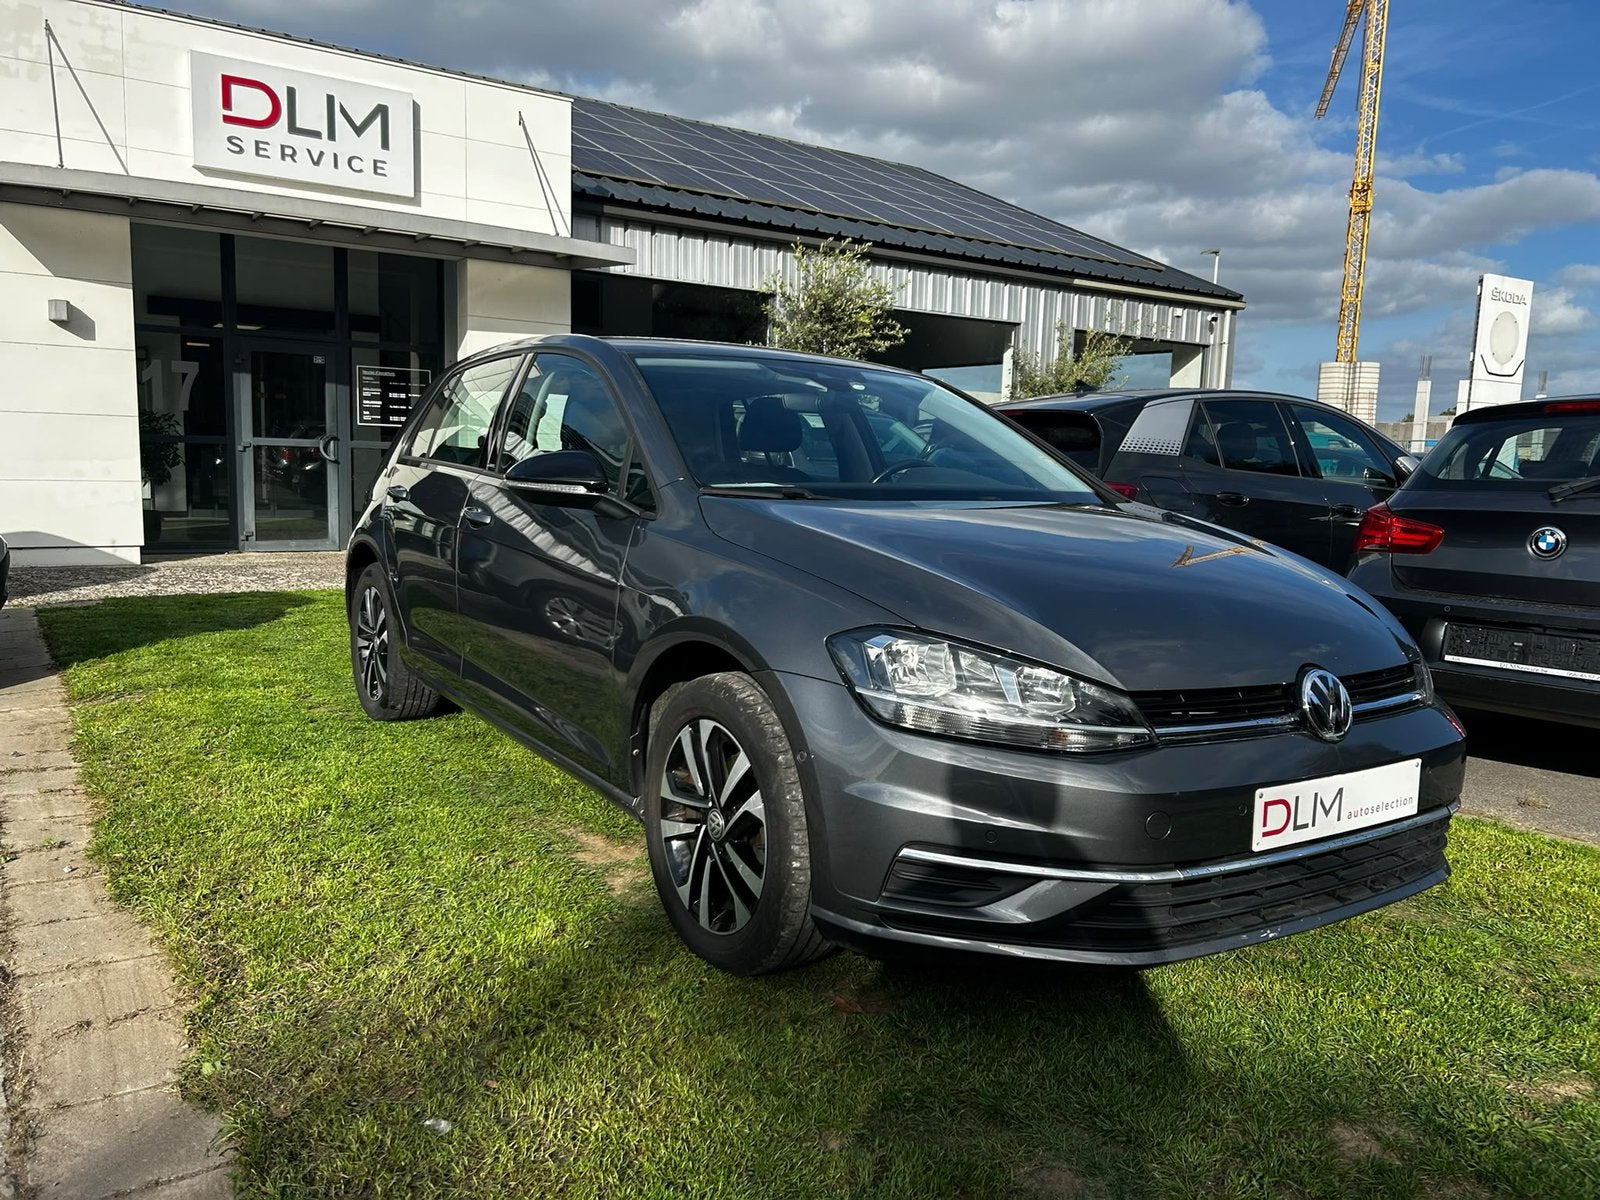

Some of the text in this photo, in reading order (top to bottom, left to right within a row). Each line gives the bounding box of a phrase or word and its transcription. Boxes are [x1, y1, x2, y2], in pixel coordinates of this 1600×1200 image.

[221, 74, 390, 151] DLM
[226, 135, 388, 177] SERVICE
[1491, 286, 1527, 306] ŠKODA
[141, 358, 200, 412] 17
[1261, 787, 1414, 838] DLM autoselection
